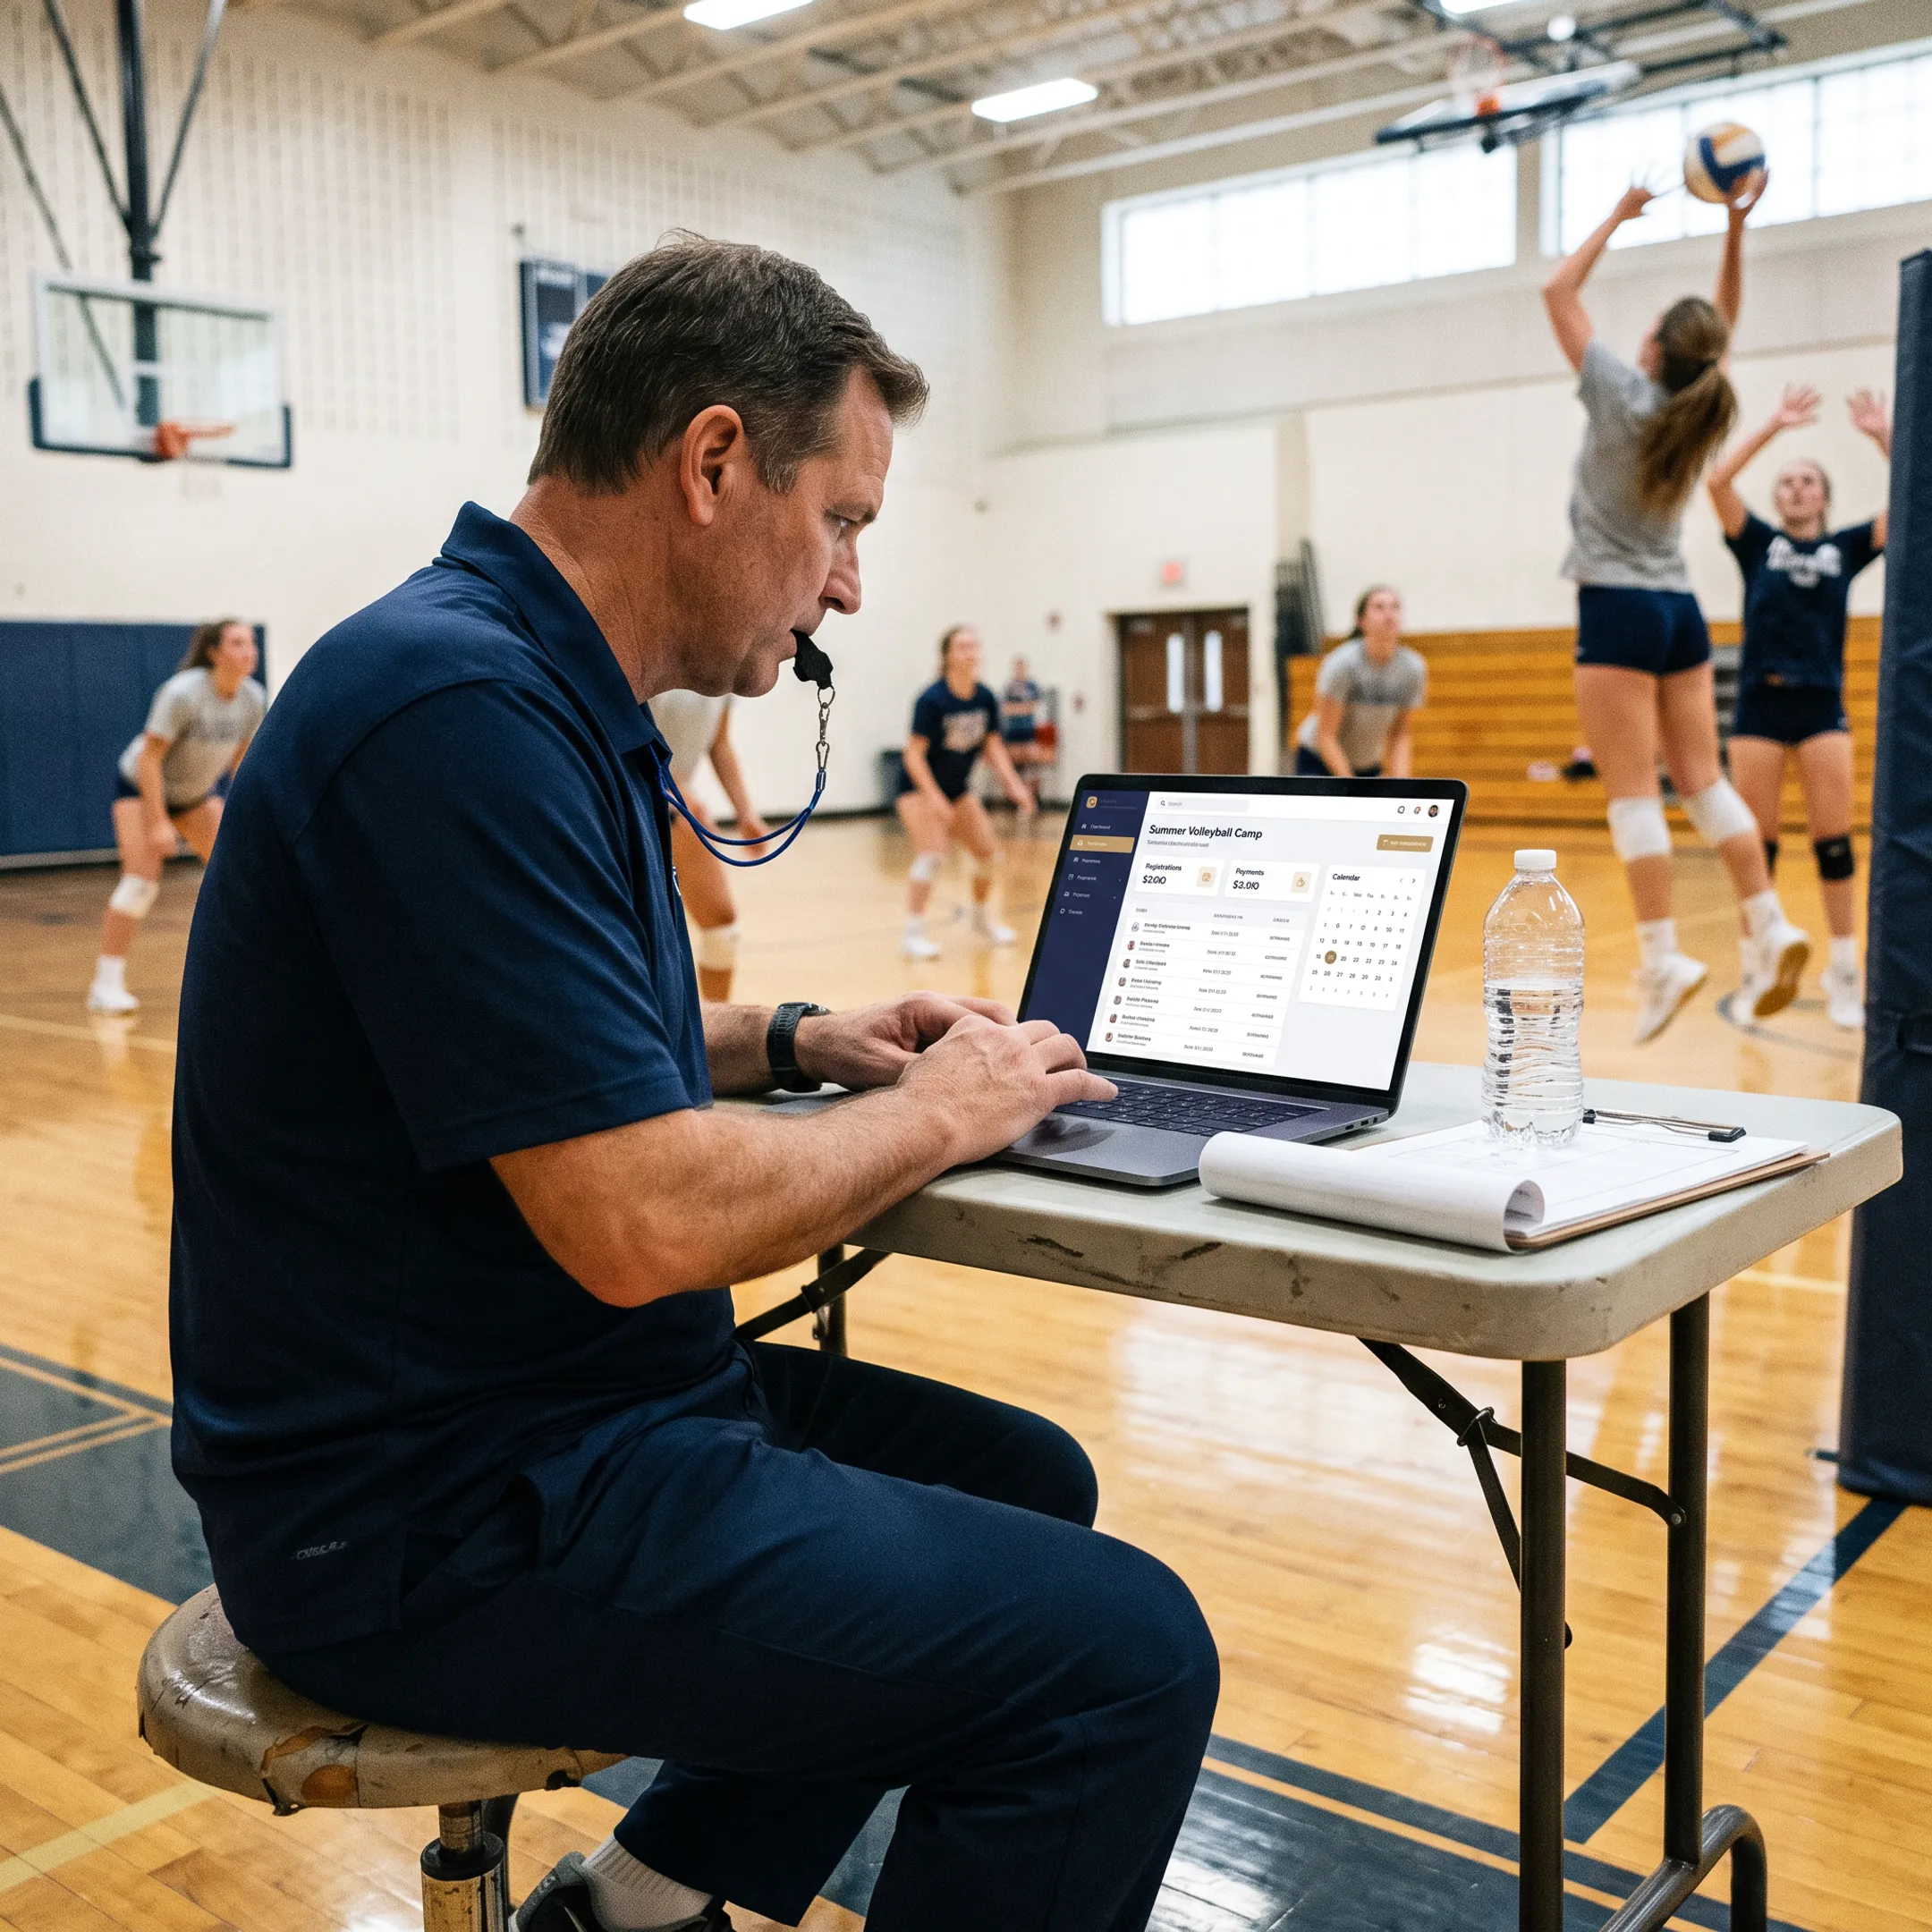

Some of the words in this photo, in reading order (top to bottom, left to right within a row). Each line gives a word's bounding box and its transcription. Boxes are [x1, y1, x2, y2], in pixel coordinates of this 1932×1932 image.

[1148, 825, 1186, 835] Summer
[1189, 826, 1233, 839] Volleyball
[1234, 828, 1263, 840] Camp
[1145, 863, 1182, 871] Registrations
[1332, 873, 1360, 882] Calendar
